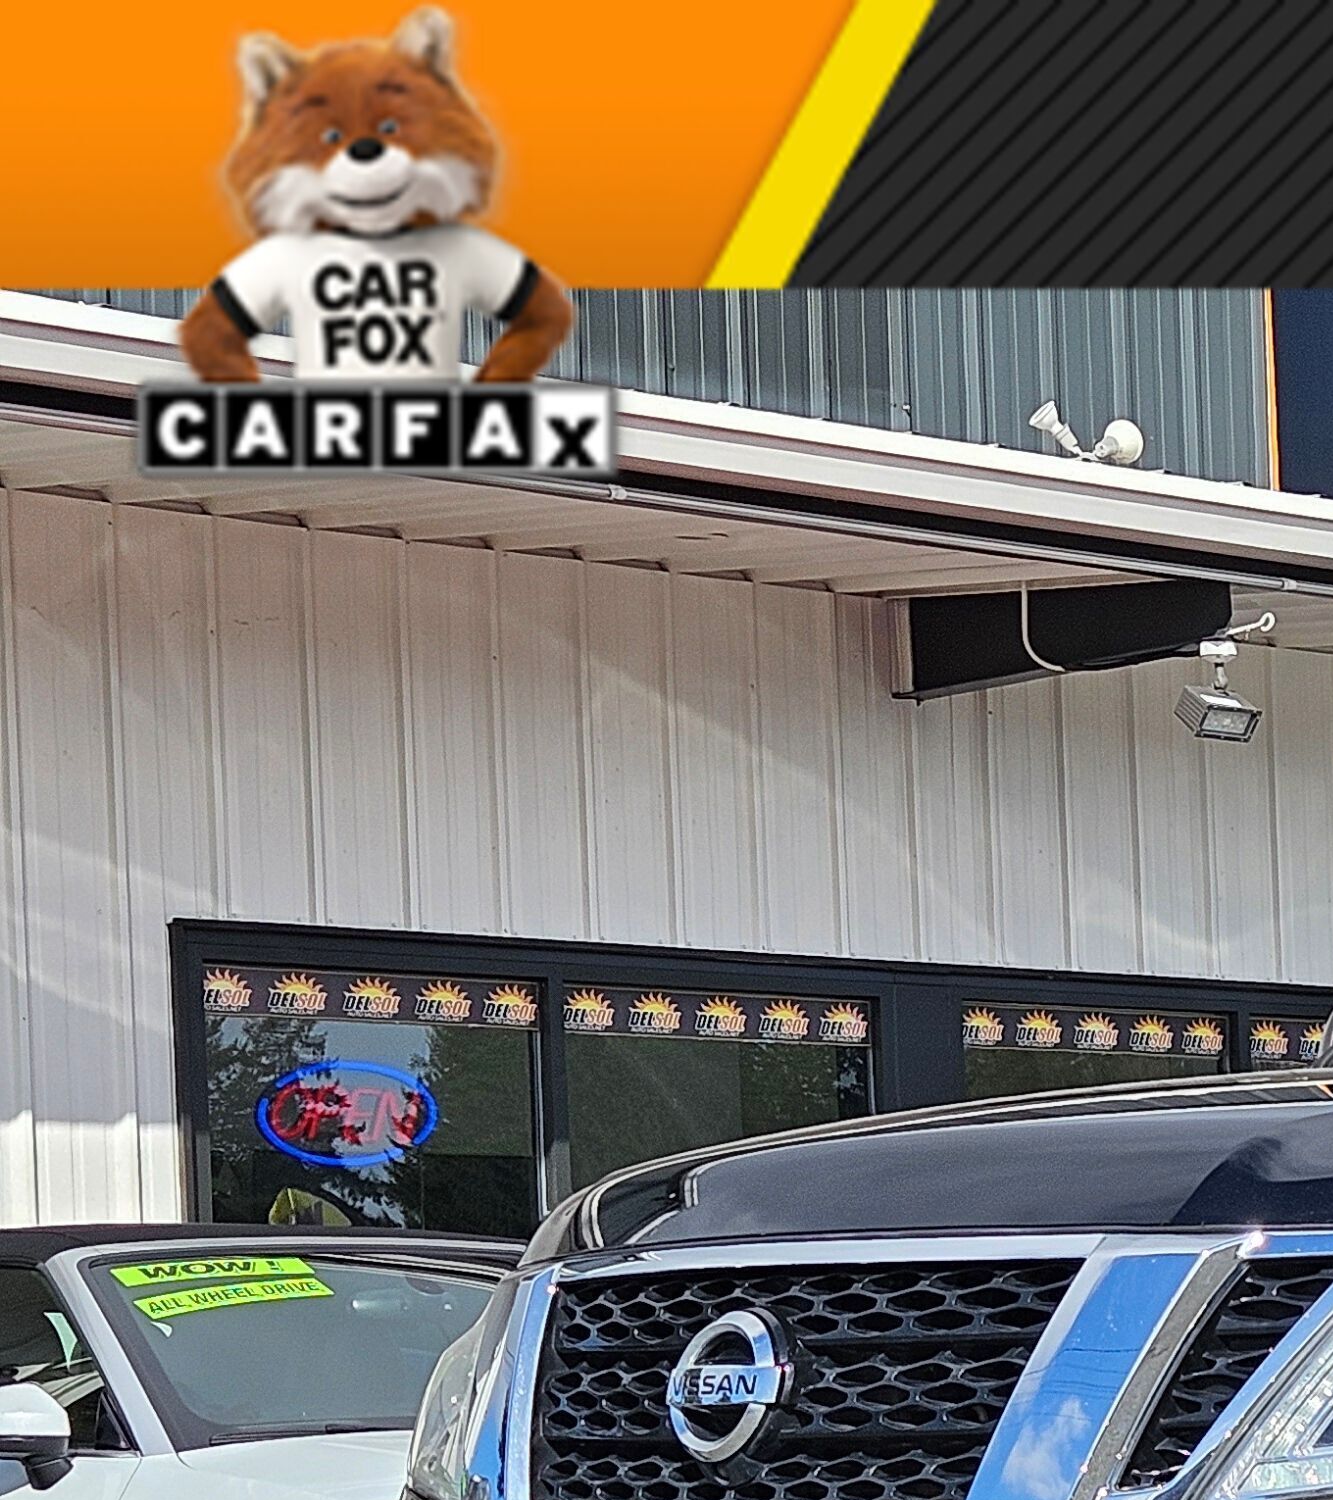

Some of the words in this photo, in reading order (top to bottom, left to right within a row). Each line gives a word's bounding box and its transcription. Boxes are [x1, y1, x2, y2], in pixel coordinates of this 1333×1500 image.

[204, 988, 252, 1006] ELSOL
[268, 991, 327, 1010] DELSOL
[343, 994, 400, 1013] DELSOL
[415, 998, 472, 1017] DELSOL
[483, 1002, 537, 1021] DELSOL
[564, 1008, 614, 1026] DELSOL
[628, 1011, 681, 1029] DELSOL
[695, 1014, 746, 1032] DELSOL
[759, 1017, 810, 1035] DELSOL
[819, 1020, 868, 1038] DELSOL
[1016, 1026, 1062, 1043] DELSOL
[1074, 1029, 1119, 1046] DELSOL
[1129, 1032, 1174, 1048] DELSOL
[1182, 1034, 1224, 1051] DELSOL
[1299, 1039, 1321, 1055] DEL
[270, 1083, 420, 1146] OPEN
[149, 1297, 184, 1313] ALL
[189, 1287, 258, 1305] WHEEL
[262, 1281, 320, 1296] DRIVE
